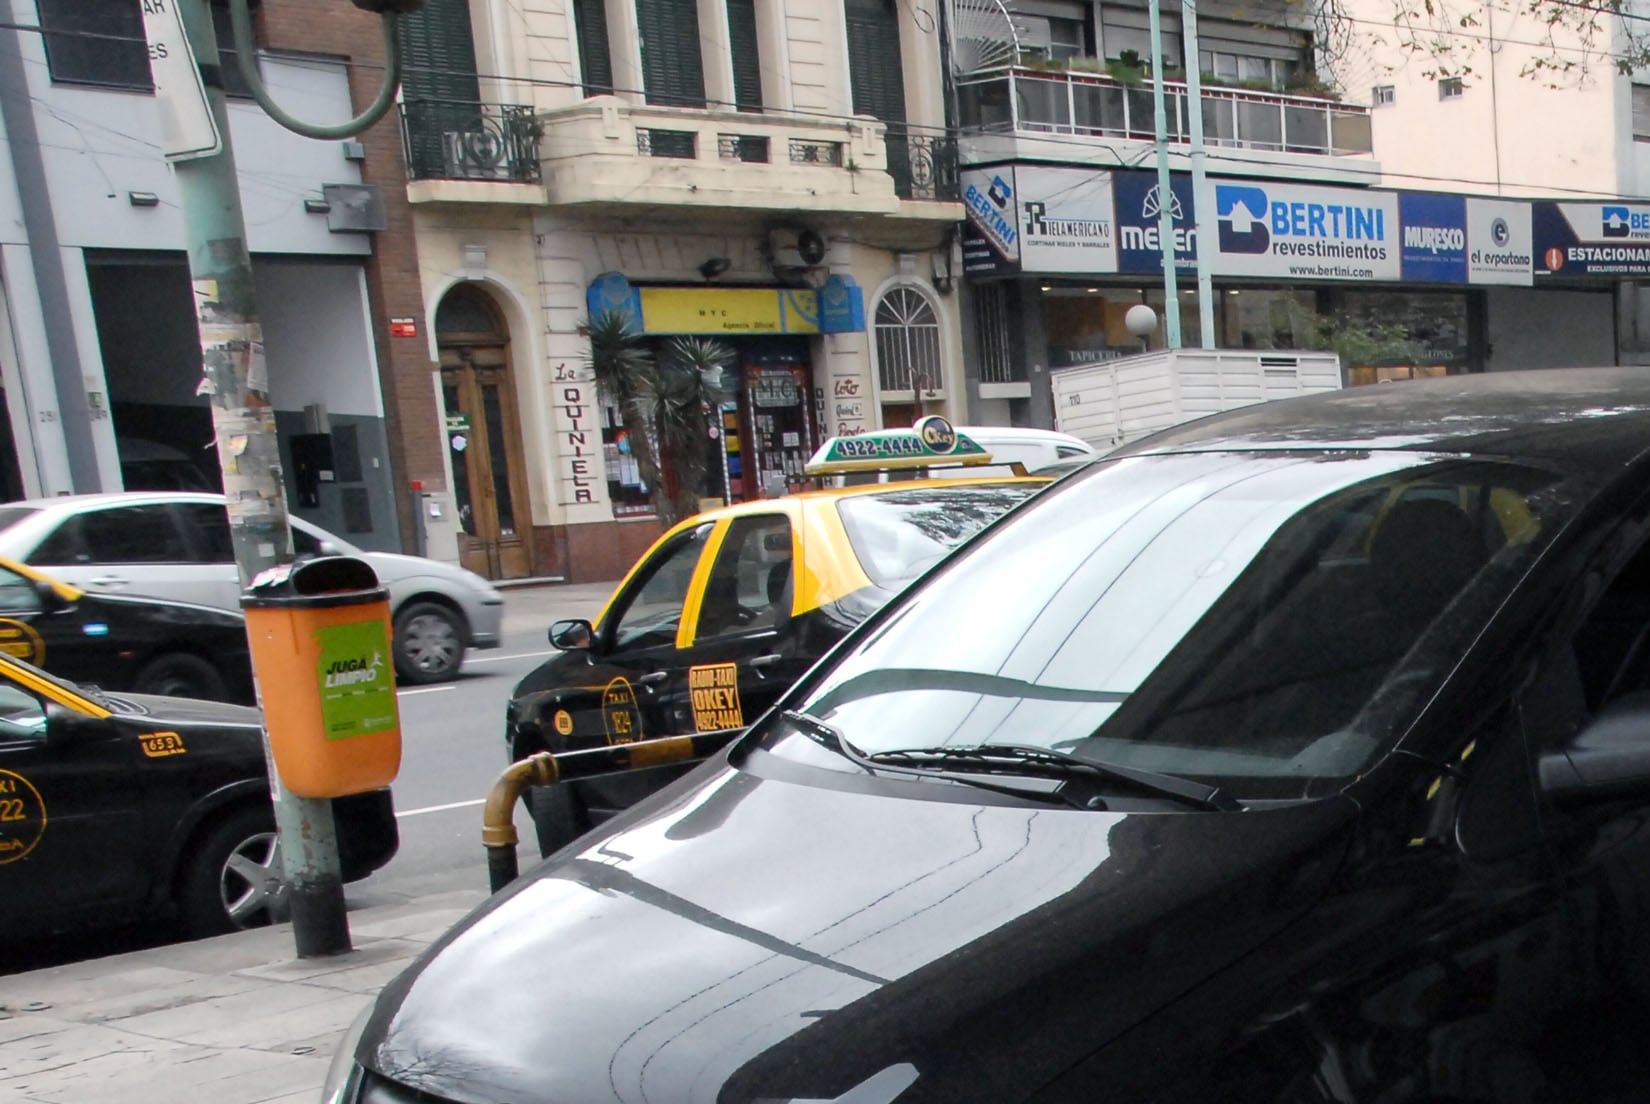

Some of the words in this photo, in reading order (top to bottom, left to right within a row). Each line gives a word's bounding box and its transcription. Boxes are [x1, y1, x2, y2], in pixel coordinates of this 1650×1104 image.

[965, 184, 1017, 246] BERTINI
[1271, 201, 1385, 241] BERTINI
[1272, 240, 1387, 260] revestimientos
[1404, 226, 1465, 255] MURESCO
[1470, 250, 1481, 265] el
[1484, 251, 1531, 268] espartano
[1586, 265, 1628, 273] EXCLUSIVOS
[1629, 265, 1647, 273] PARA
[1288, 265, 1374, 279] www.bertini.com
[563, 387, 593, 504] QUINIELA
[836, 437, 922, 457] 4922-4444
[693, 687, 735, 711] OKEY
